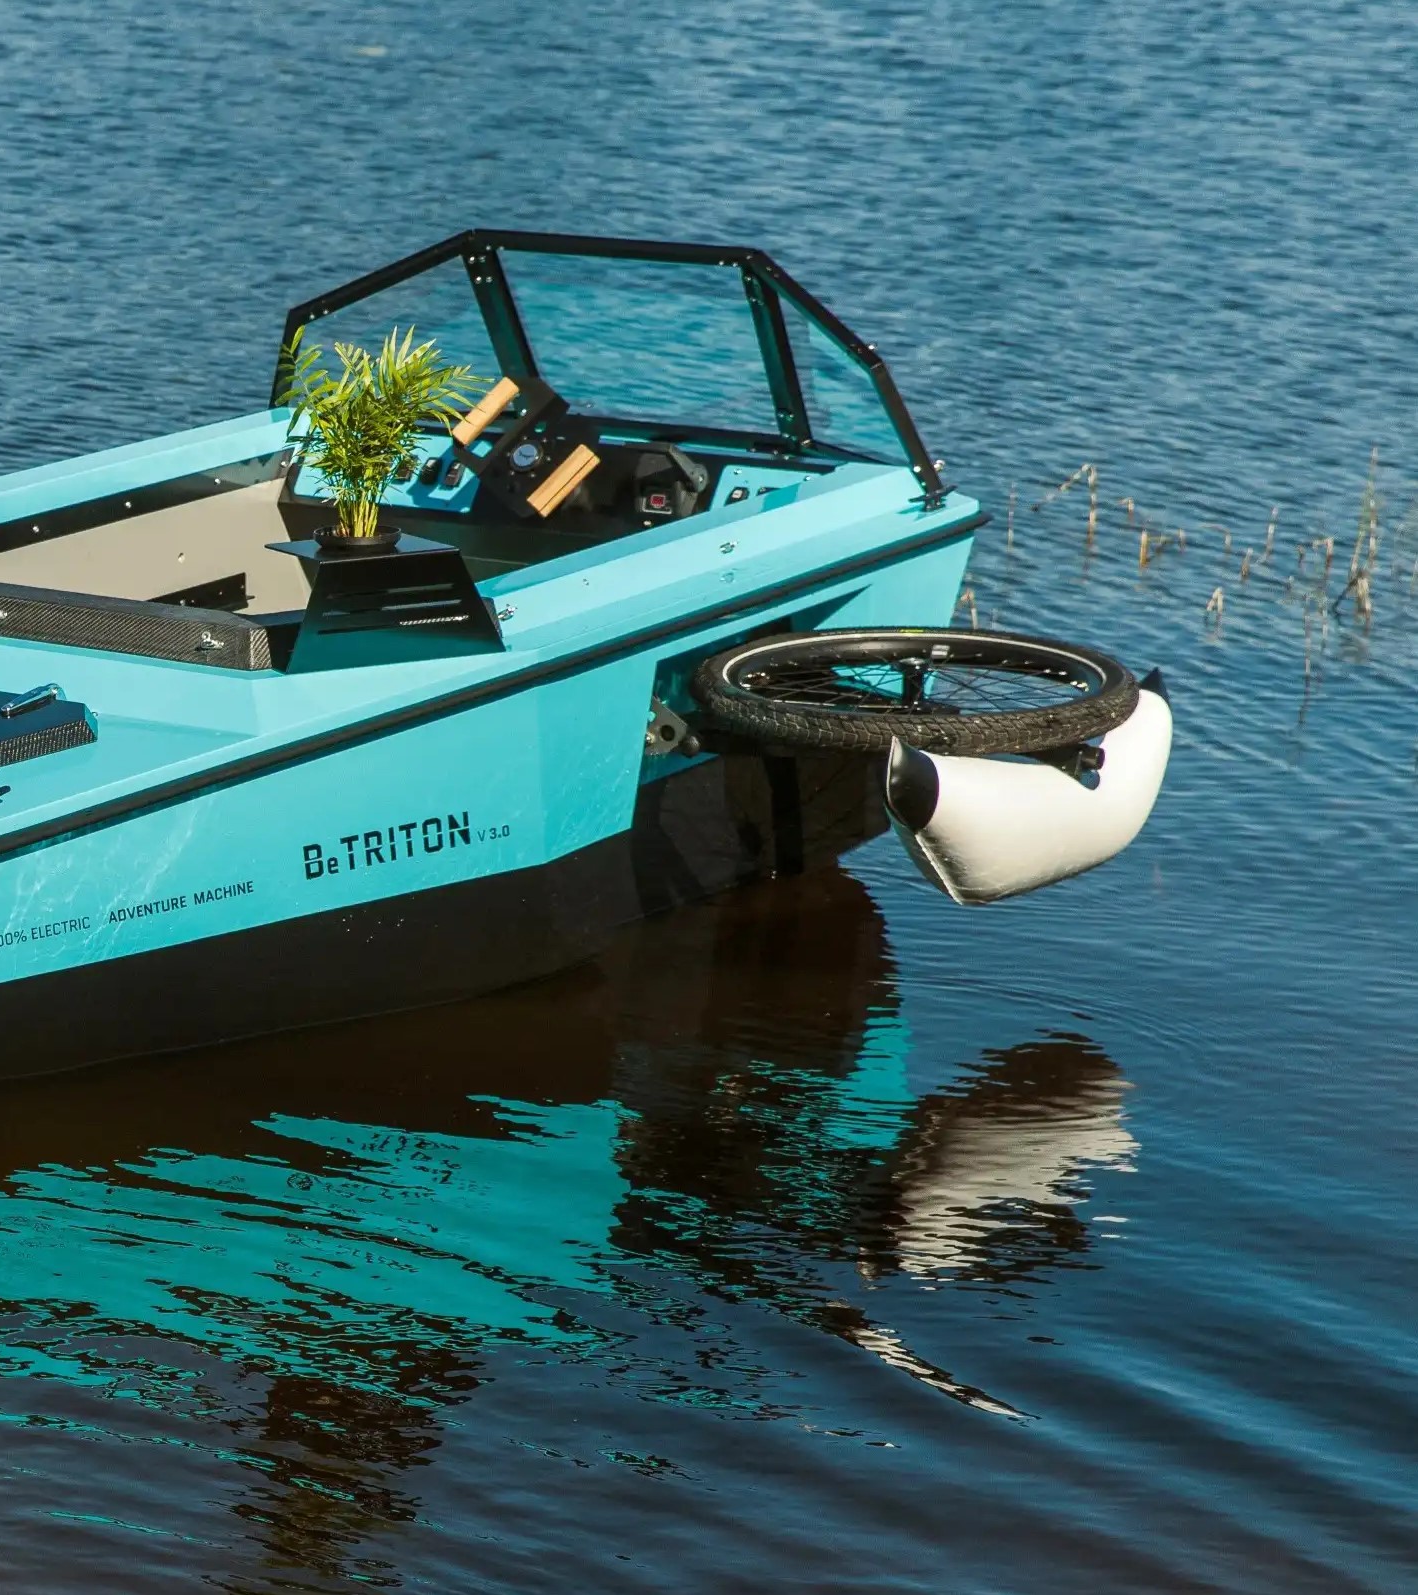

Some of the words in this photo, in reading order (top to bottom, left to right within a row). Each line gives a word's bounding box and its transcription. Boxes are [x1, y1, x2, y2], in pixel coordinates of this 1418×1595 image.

[31, 916, 91, 940] ELECTRIC
[108, 895, 188, 924] ADVENTURE
[193, 880, 255, 905] MACHINE
